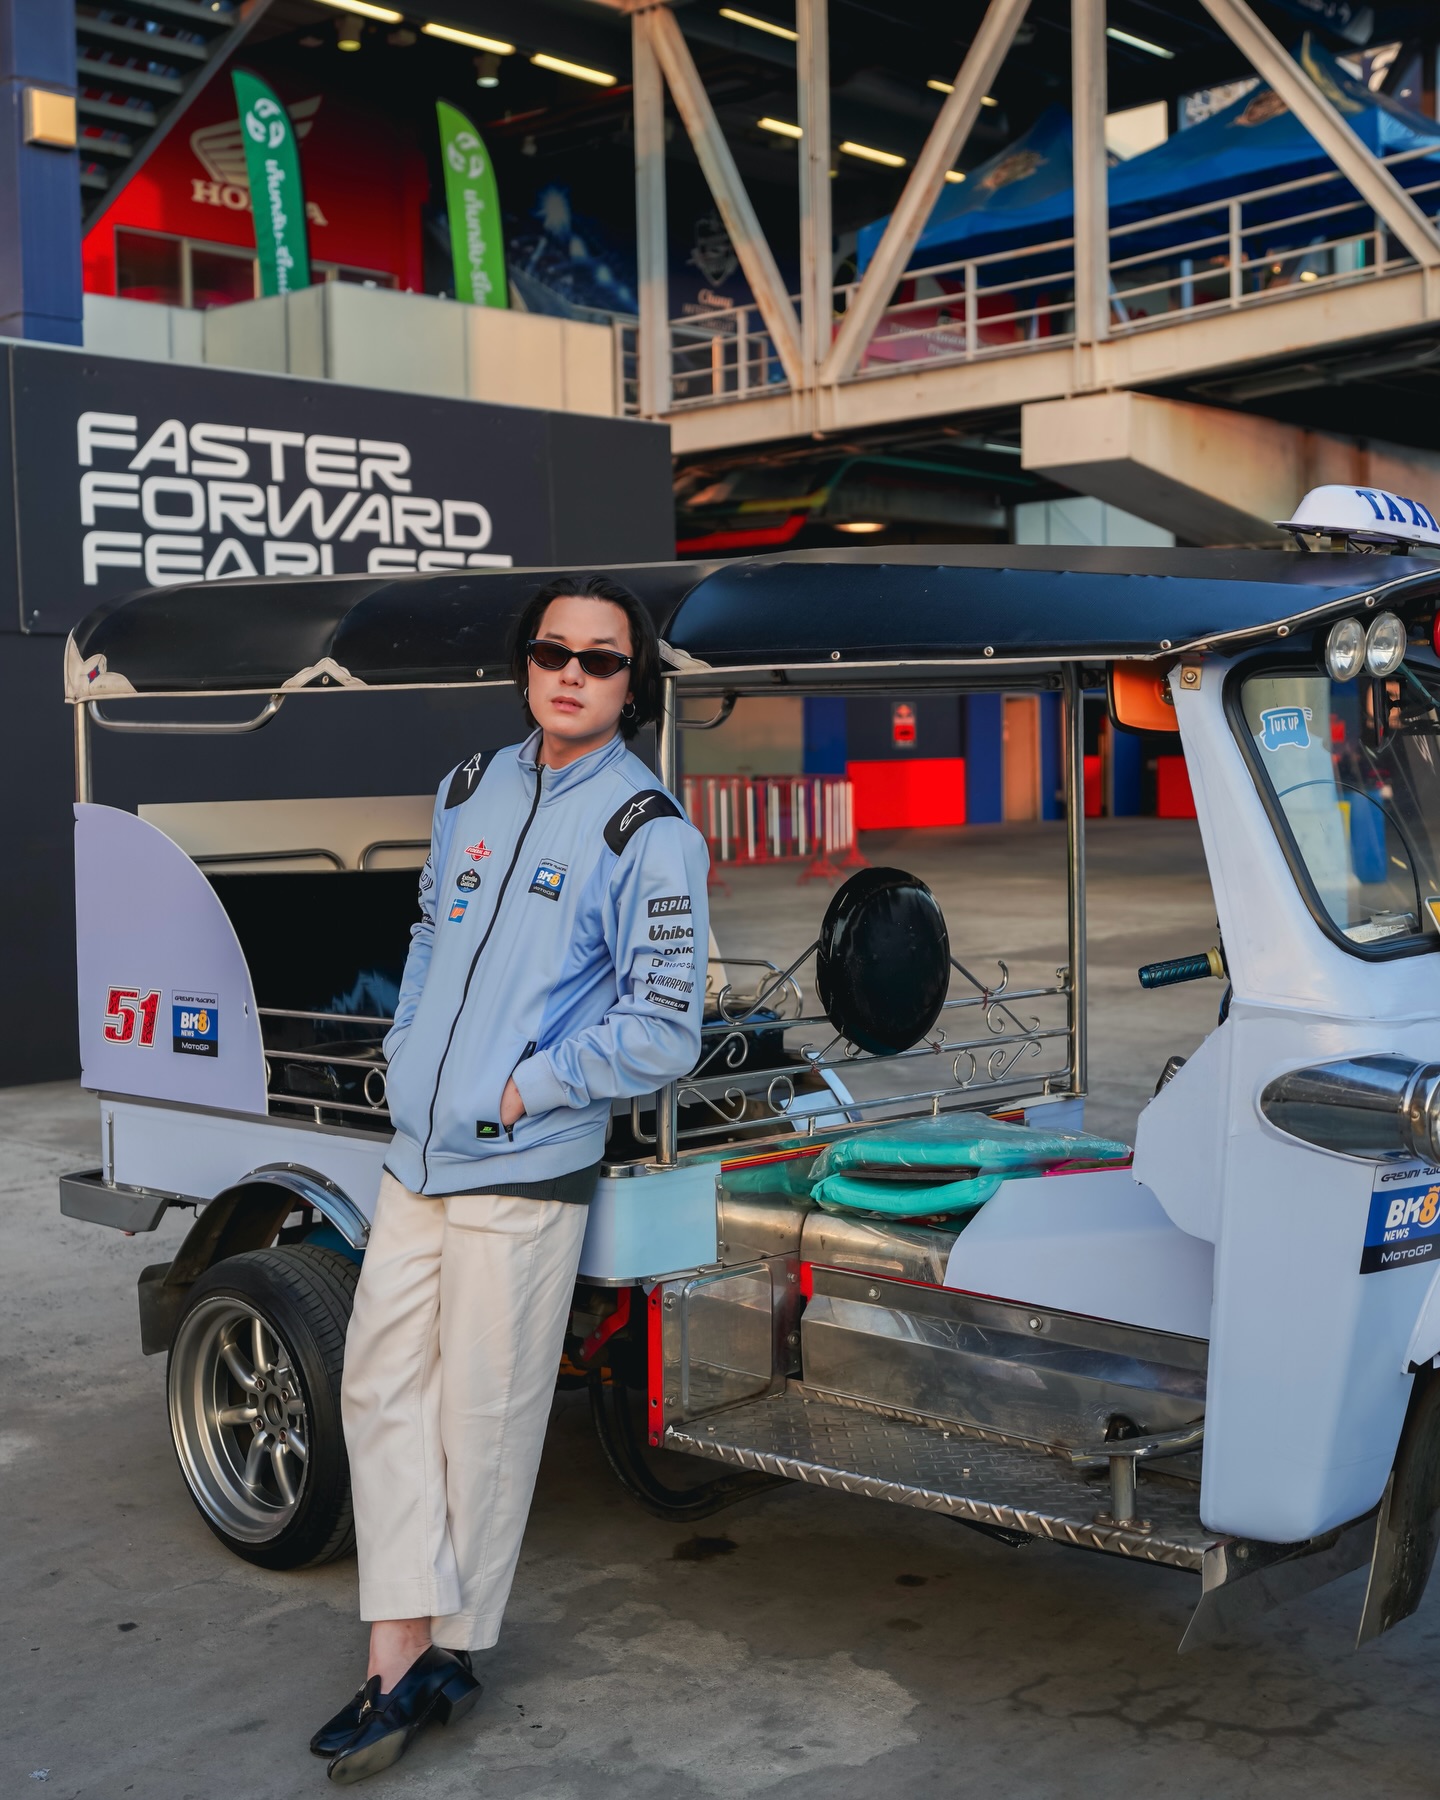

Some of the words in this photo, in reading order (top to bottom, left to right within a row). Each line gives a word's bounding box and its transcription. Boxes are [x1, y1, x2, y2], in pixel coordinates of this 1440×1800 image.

[191, 179, 328, 226] HOA
[77, 411, 411, 492] FASTER
[80, 471, 492, 549] FORWARD
[1355, 490, 1439, 532] TAXI
[1268, 713, 1287, 735] TUK
[1288, 716, 1299, 731] UP
[103, 985, 162, 1050] 51
[180, 1010, 209, 1033] BK8
[181, 1029, 195, 1037] NEWS
[1381, 1169, 1421, 1182] GRESINI
[1385, 1190, 1439, 1229] BK8
[1383, 1227, 1410, 1242] NEWS
